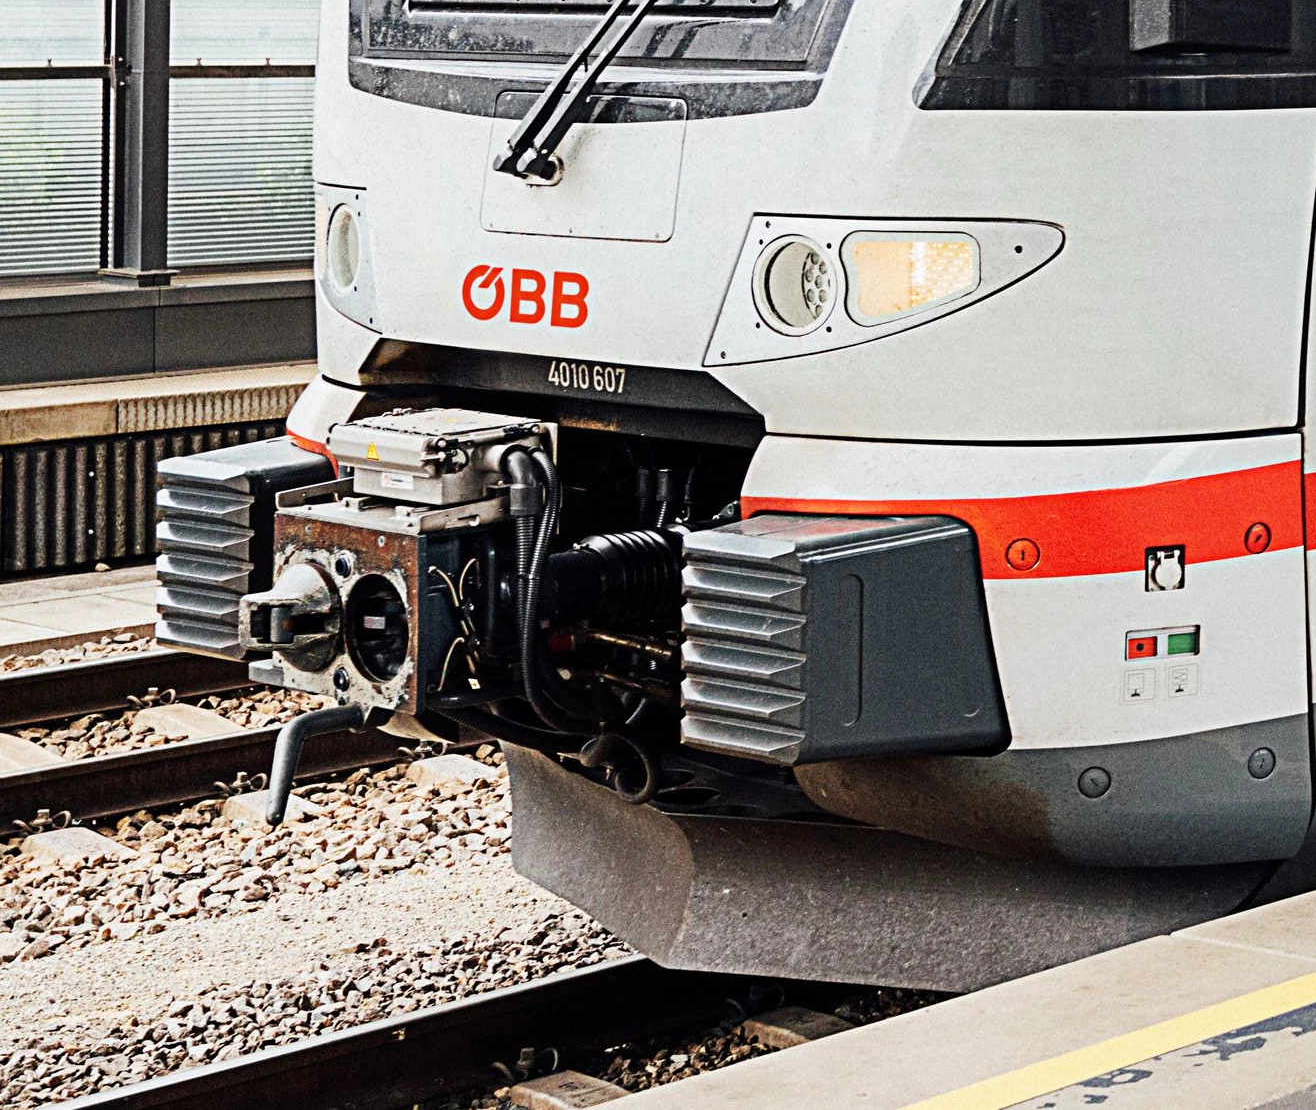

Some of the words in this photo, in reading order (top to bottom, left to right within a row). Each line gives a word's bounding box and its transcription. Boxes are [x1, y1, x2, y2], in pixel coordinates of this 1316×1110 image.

[461, 264, 590, 329] ÖBB
[548, 360, 590, 390] 4010
[593, 365, 626, 394] 607
